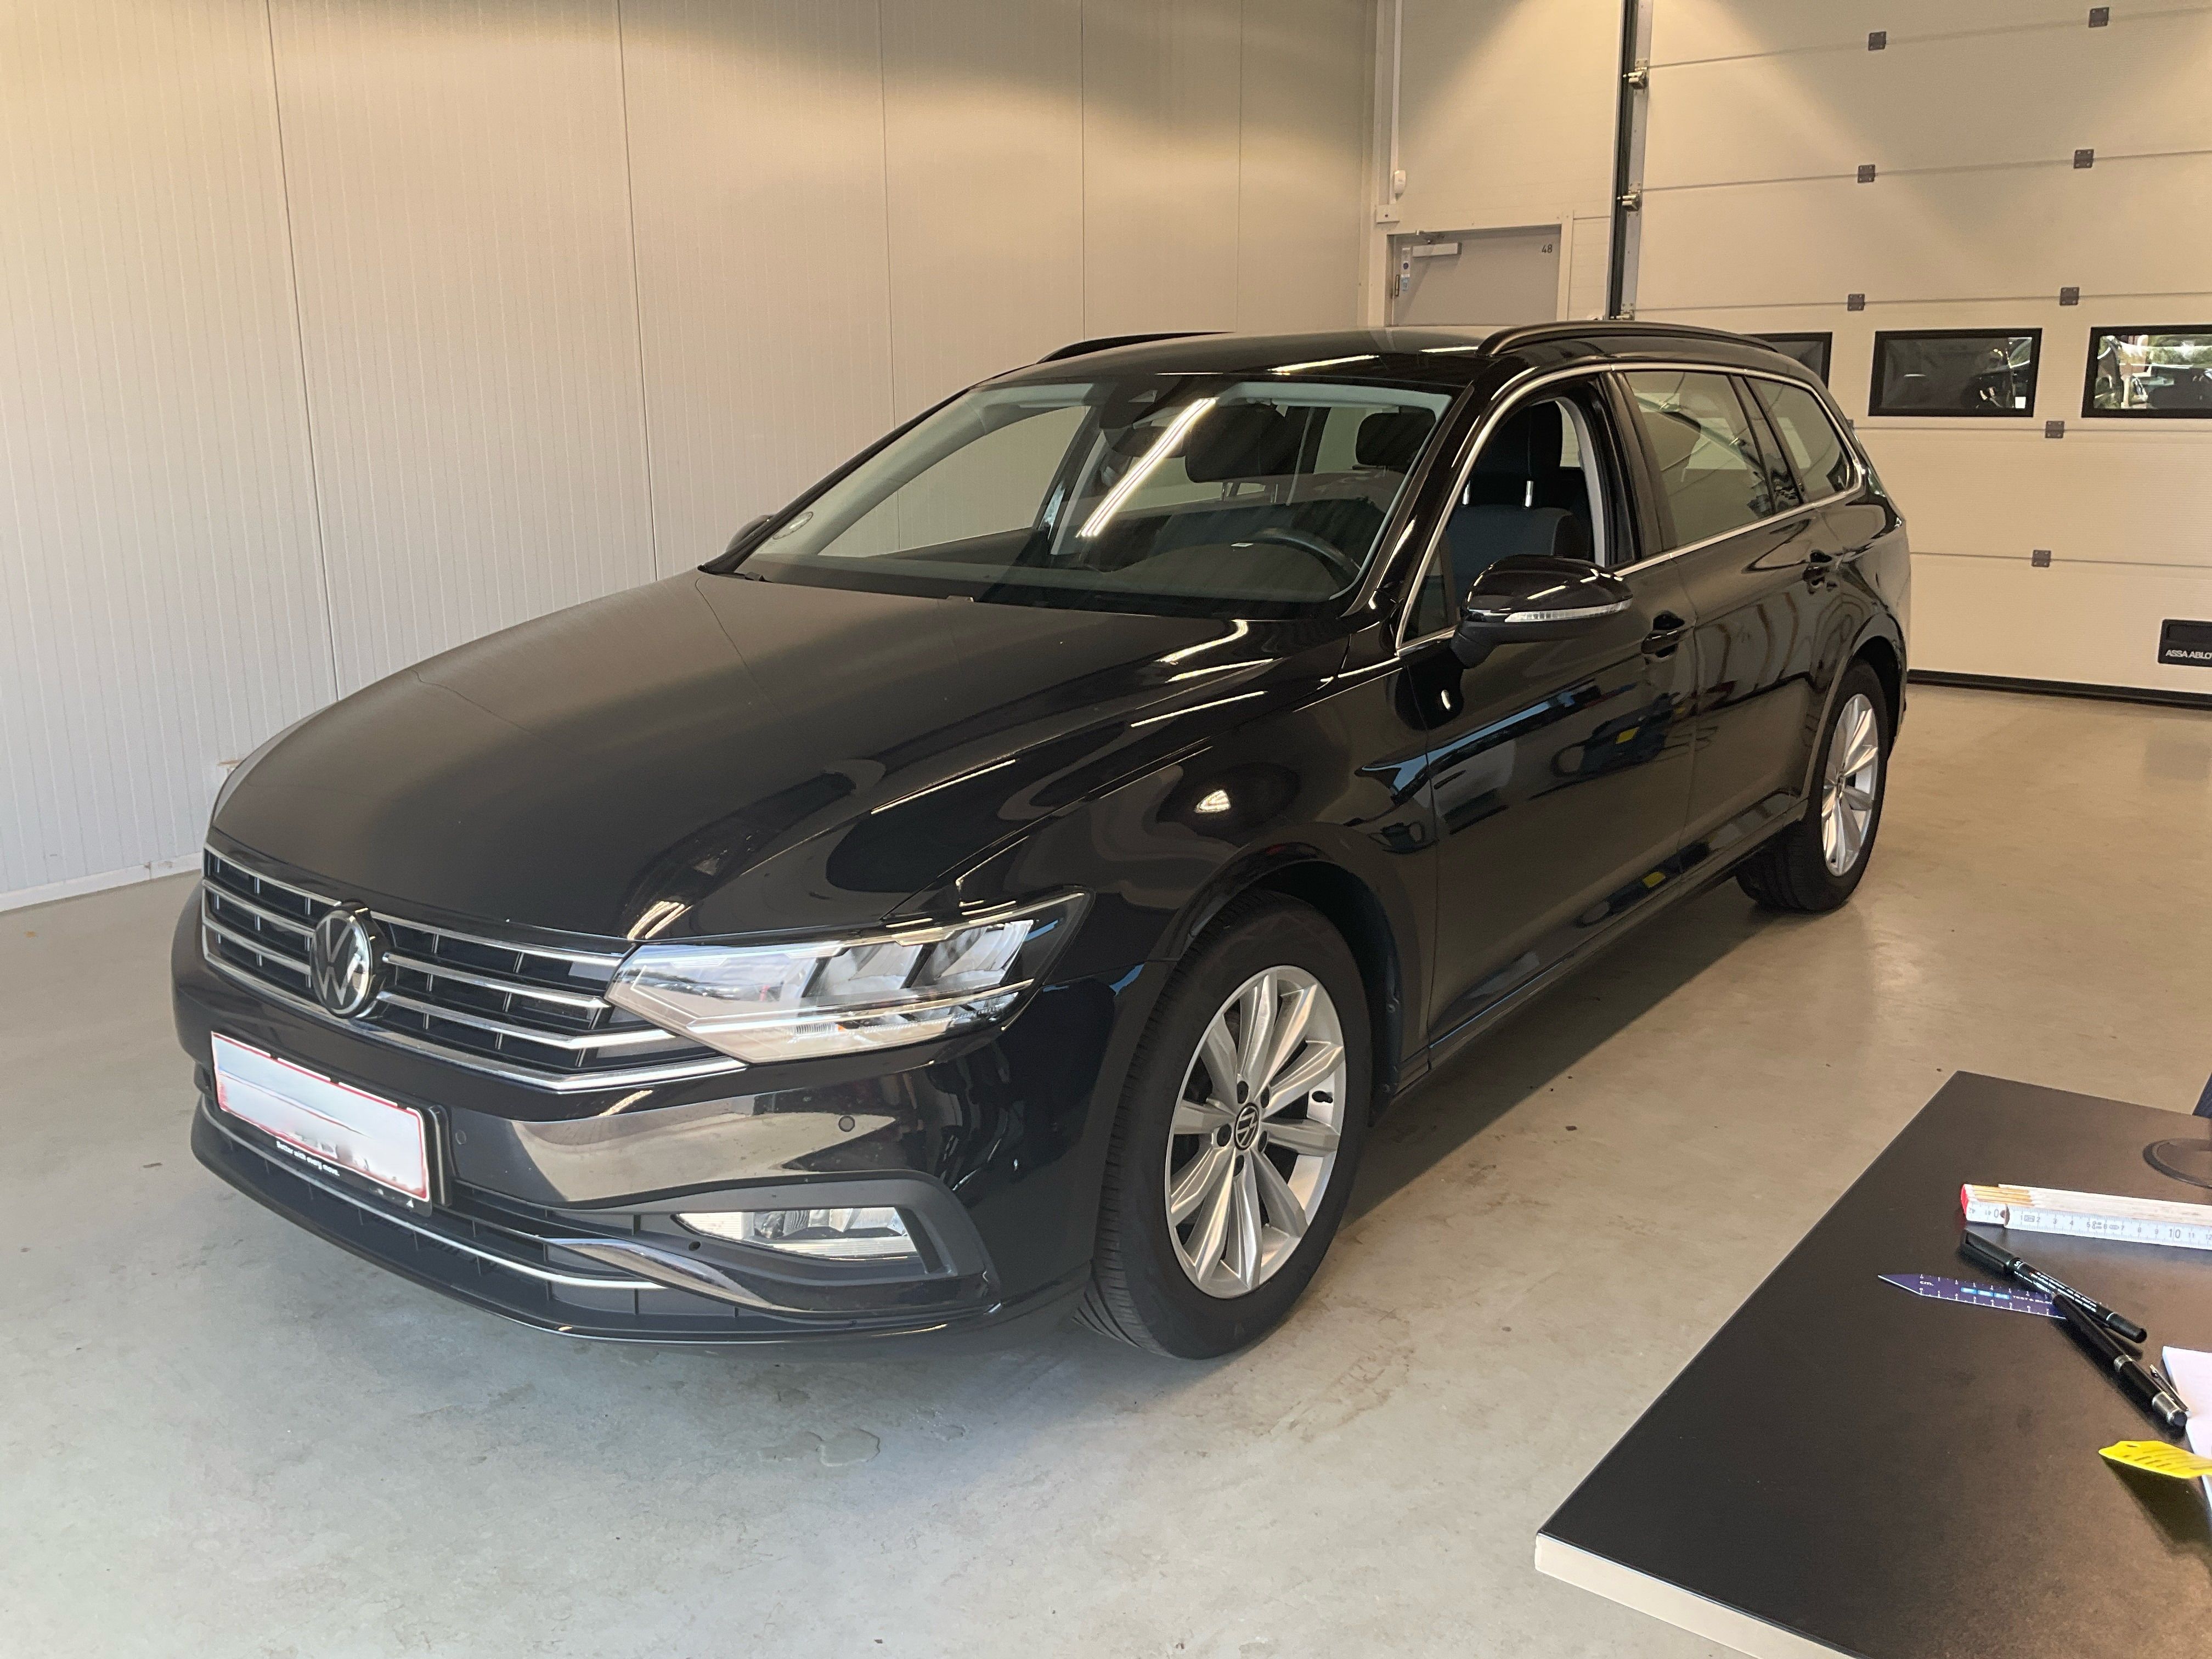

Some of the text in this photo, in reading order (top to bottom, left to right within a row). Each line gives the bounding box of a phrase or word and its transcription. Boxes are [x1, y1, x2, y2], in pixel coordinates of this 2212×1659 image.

[1542, 244, 1553, 253] 48
[2165, 650, 2212, 659] ASSA ABLO
[312, 911, 370, 1013] VW
[276, 1141, 294, 1154] Better
[1994, 1209, 1999, 1218] 0
[2169, 1228, 2181, 1239] 10
